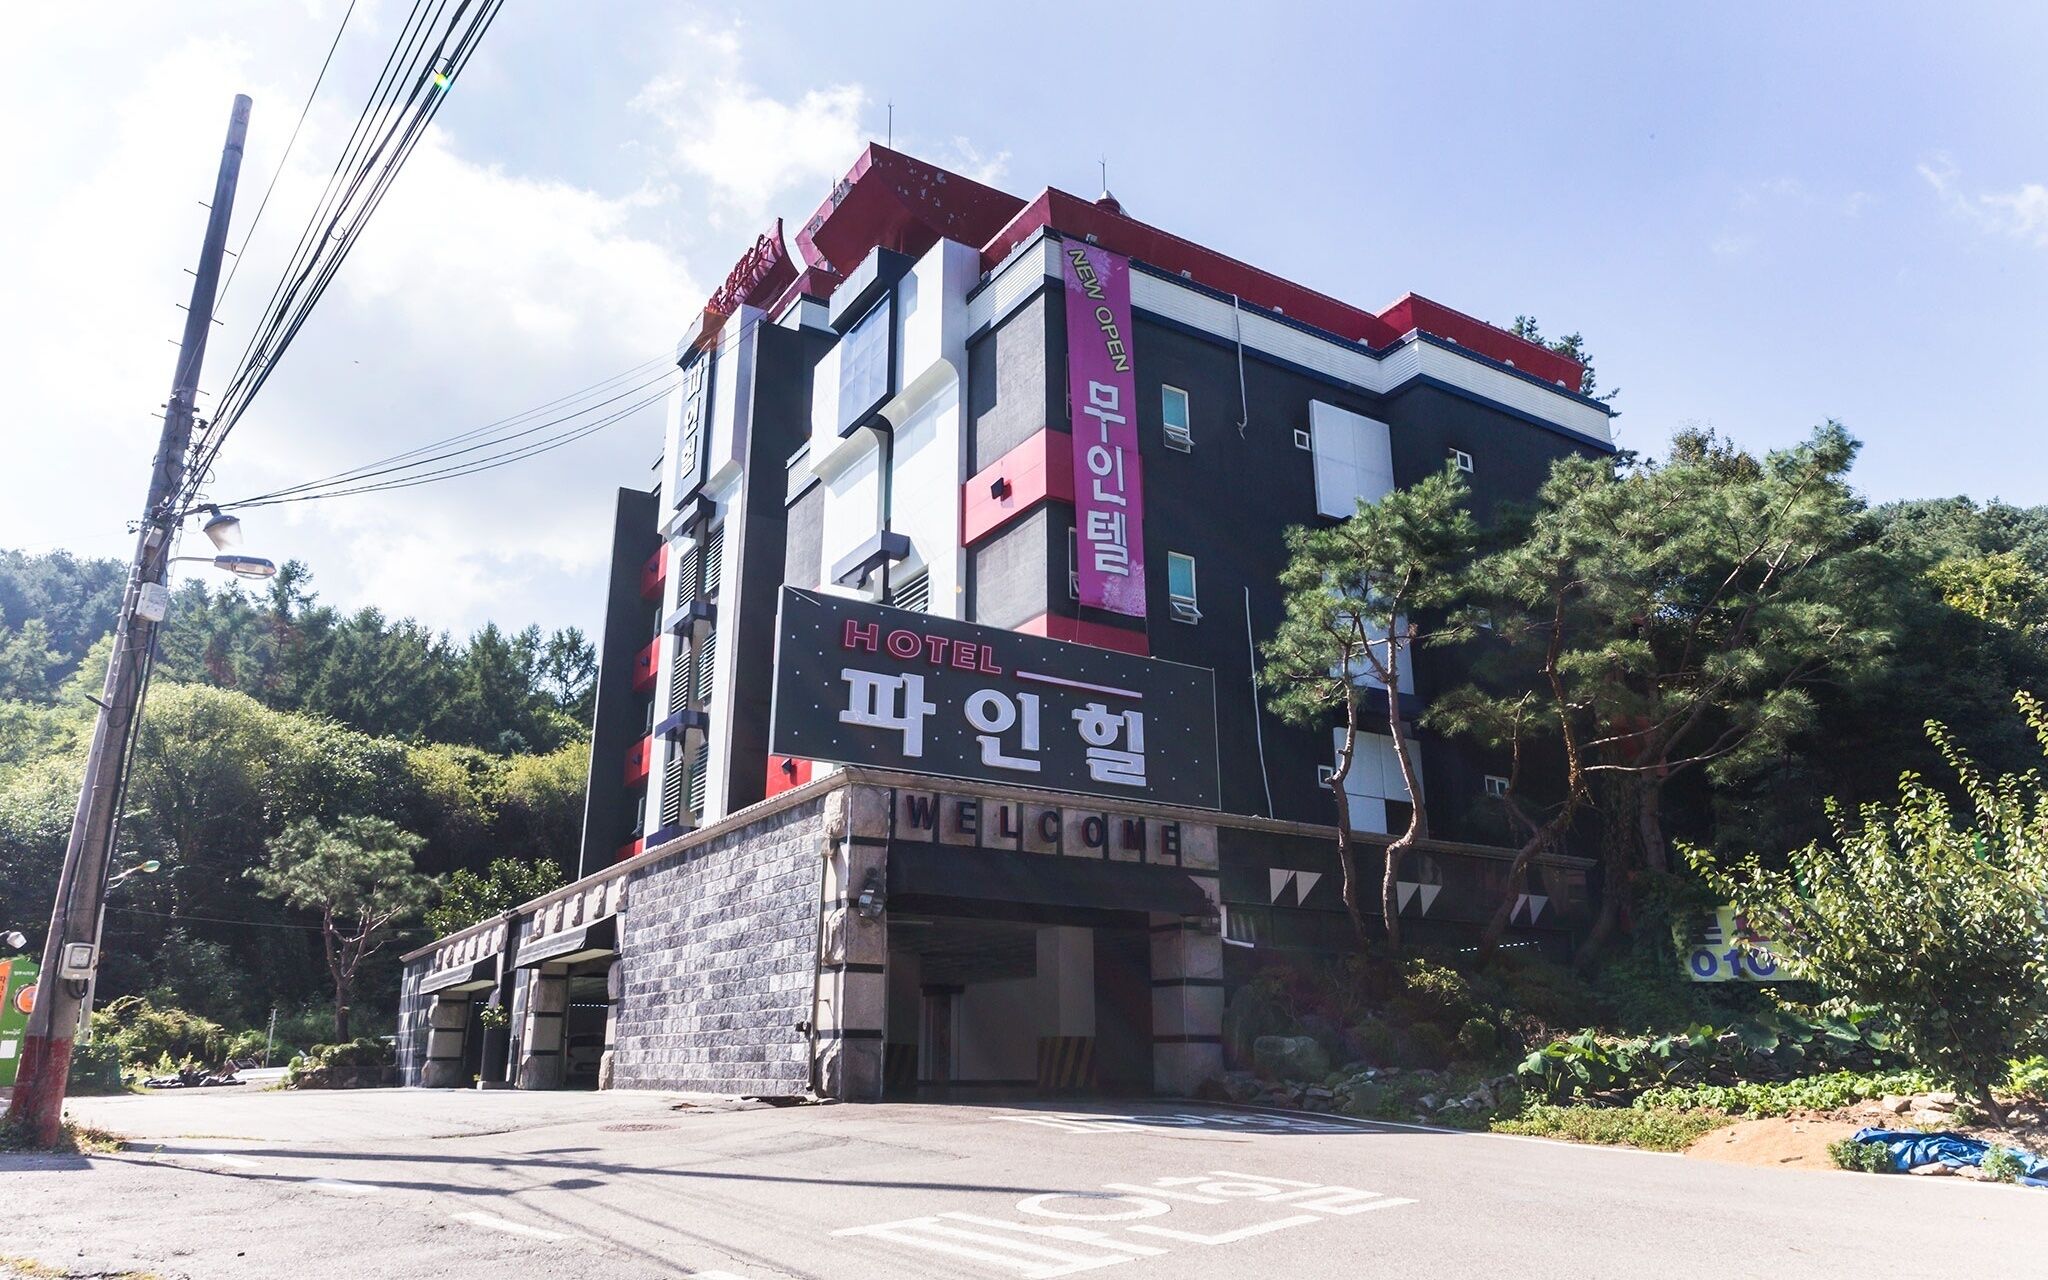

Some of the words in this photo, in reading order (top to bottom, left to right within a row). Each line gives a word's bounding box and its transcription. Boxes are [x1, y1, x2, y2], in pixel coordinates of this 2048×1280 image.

[1069, 249, 1105, 300] NEW
[1094, 305, 1131, 373] OPEN
[1083, 379, 1130, 576] 무인텔
[841, 618, 1003, 675] HOTEL
[838, 667, 1147, 787] 파인힐
[906, 794, 1181, 856] WELCOME
[829, 1170, 1420, 1280] 파인힐
